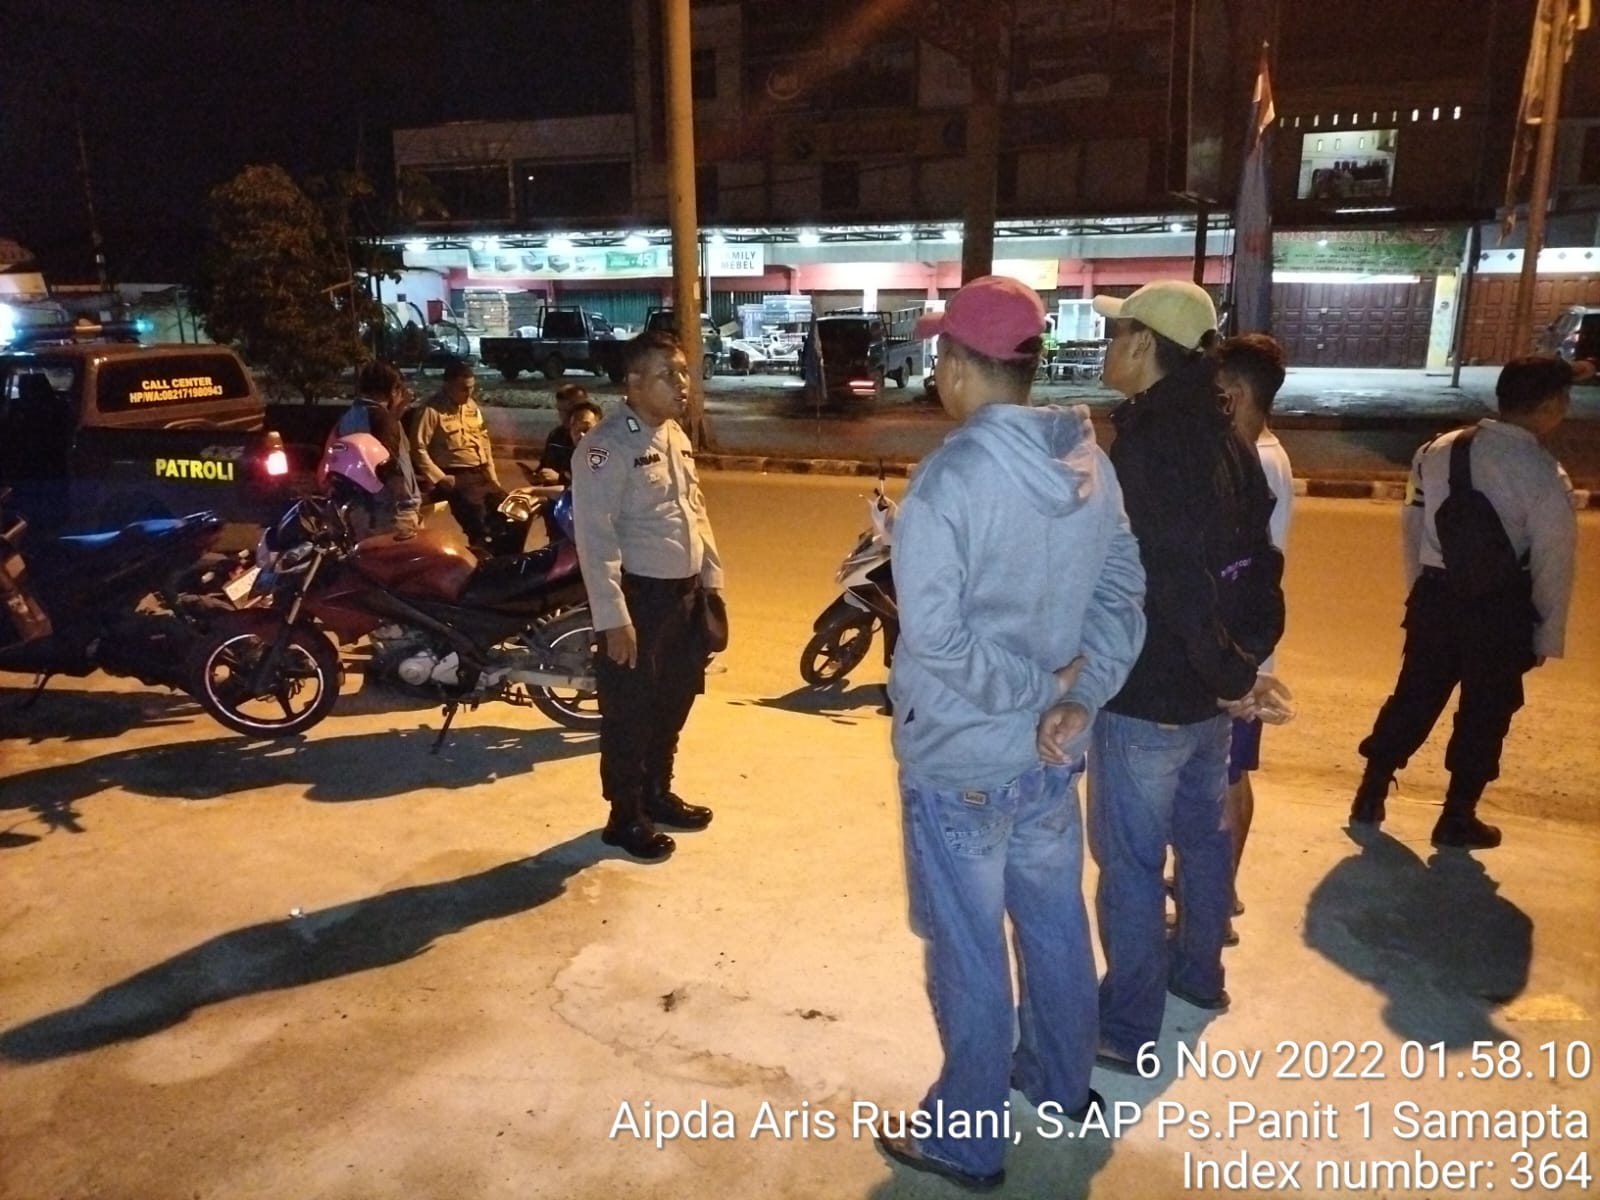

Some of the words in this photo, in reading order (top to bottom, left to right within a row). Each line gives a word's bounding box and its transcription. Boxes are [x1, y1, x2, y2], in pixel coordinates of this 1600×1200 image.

[721, 260, 755, 270] MEBEL
[142, 379, 170, 391] CALL
[171, 376, 213, 388] CENTER
[155, 458, 233, 480] PATROLI
